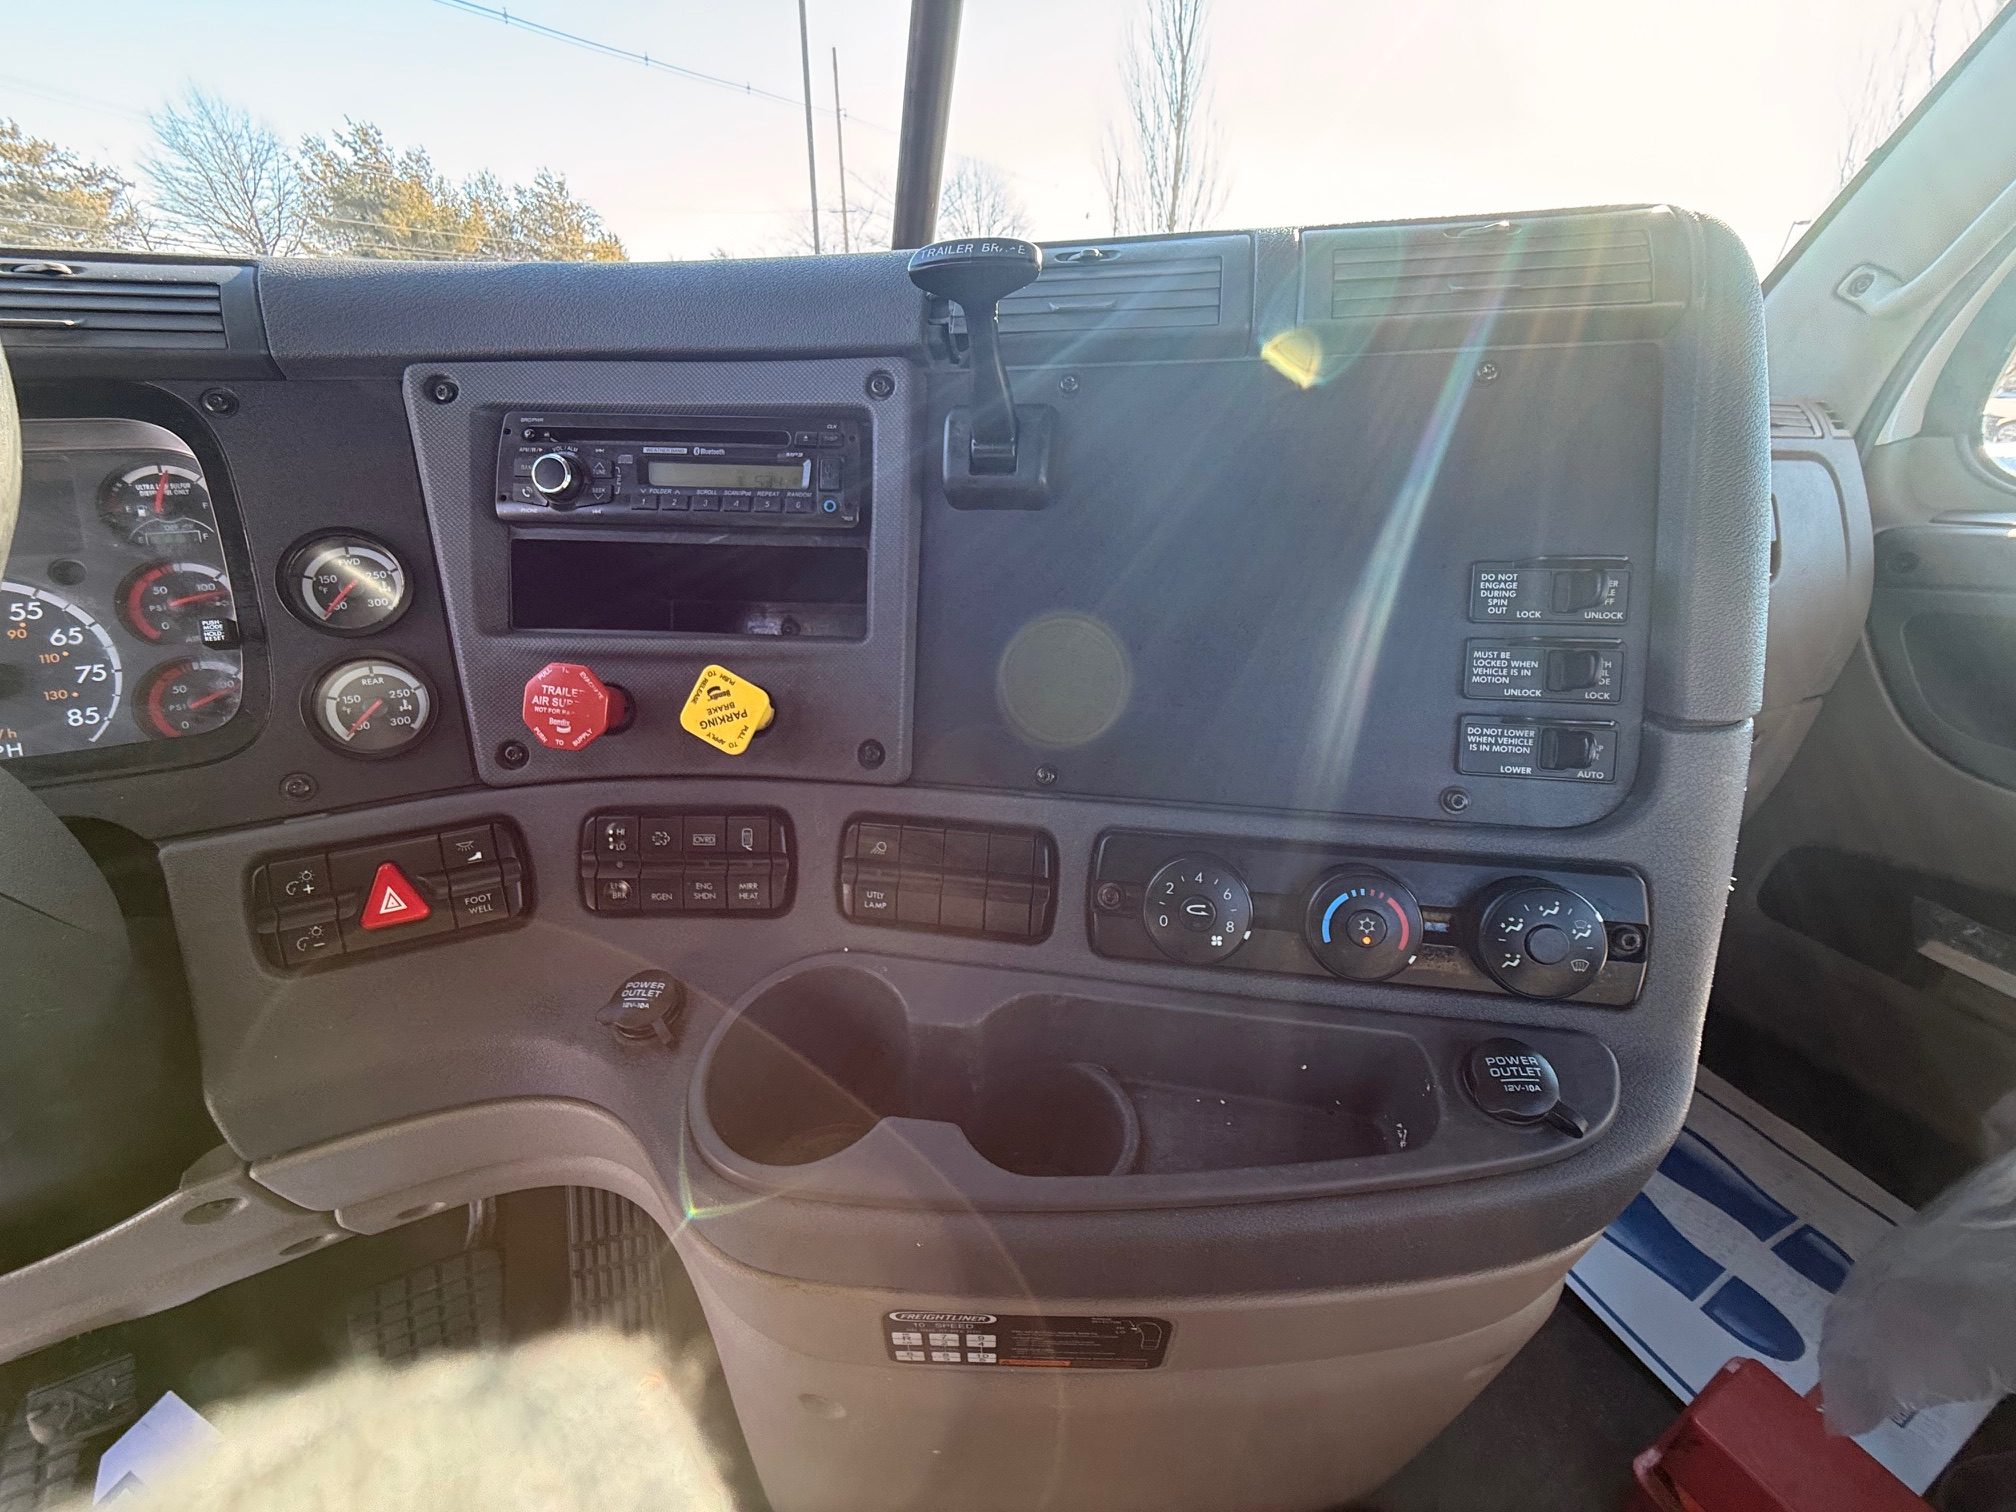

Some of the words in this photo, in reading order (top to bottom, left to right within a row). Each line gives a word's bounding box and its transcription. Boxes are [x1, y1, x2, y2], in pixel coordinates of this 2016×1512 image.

[920, 243, 974, 260] TRAILER
[981, 243, 1025, 255] BRE
[672, 498, 677, 506] 2
[338, 557, 360, 567] FWD
[319, 574, 338, 584] 150
[366, 570, 387, 580] 250
[1481, 573, 1496, 581] DO
[1498, 573, 1518, 581] NOT
[153, 586, 168, 595] 50
[196, 582, 217, 592] 100
[1480, 581, 1518, 590] ENGAGE
[1480, 590, 1517, 598] DURING
[368, 598, 389, 608] 300
[1487, 598, 1508, 606] SPIN
[9, 601, 43, 622] 55
[1487, 606, 1507, 614] OUT
[7, 628, 28, 640] 90
[50, 627, 83, 647] 65
[38, 653, 60, 665] 110
[1473, 651, 1498, 659] MUST
[1473, 659, 1508, 668] LOCKED
[1510, 660, 1539, 668] WHEN
[75, 664, 107, 684] 75
[707, 670, 717, 678] TO
[1472, 668, 1508, 676] VEHICLE
[1510, 668, 1518, 676] IS
[1521, 668, 1531, 676] IN
[361, 677, 384, 686] REAR
[720, 674, 736, 687] PUSH
[1472, 676, 1510, 684] MOTION
[172, 685, 187, 694] 50
[388, 688, 411, 699] 250
[691, 678, 709, 705] RELEASE
[1504, 689, 1542, 697] UNLOCK
[43, 689, 68, 701] 130
[342, 694, 361, 704] 150
[1585, 692, 1610, 700] LOCK
[531, 696, 549, 706] AIR
[534, 706, 547, 714] NOT
[548, 707, 561, 715] FOR
[706, 701, 736, 716] BRAKE
[67, 706, 100, 727] 85
[390, 716, 411, 726] 300
[699, 709, 748, 730] PARKING
[549, 717, 571, 727] Bendix
[533, 726, 548, 743] PUSH
[555, 739, 565, 747] TO
[572, 728, 593, 747] SUPPLY
[737, 725, 750, 740] PULL
[1467, 727, 1482, 736] DO
[1483, 728, 1502, 736] NOT
[1504, 729, 1535, 737] LOWER
[706, 731, 726, 746] APPLY
[1467, 736, 1496, 744] WHEN
[1497, 737, 1534, 746] VEHICLE
[728, 741, 739, 749] TO
[1479, 744, 1490, 752] IN
[1492, 745, 1531, 754] MOTION
[1500, 765, 1532, 774] LOWER
[1577, 771, 1604, 779] AUTO
[616, 828, 625, 836] HI
[695, 836, 715, 844] OVRD
[1195, 872, 1203, 884] 4
[1166, 882, 1175, 895] 2
[464, 893, 492, 905] FOOT
[694, 892, 716, 900] SHDN
[1223, 888, 1232, 900] 6
[468, 903, 493, 914] WELL
[864, 901, 887, 909] LAMP
[1160, 914, 1168, 927] 0
[1225, 921, 1234, 933] 8
[625, 981, 666, 990] POWER
[621, 989, 662, 998] OUTLET
[1485, 1056, 1539, 1066] POWER
[1489, 1067, 1541, 1077] OUTLET
[900, 1313, 987, 1322] FREIGHTLINER
